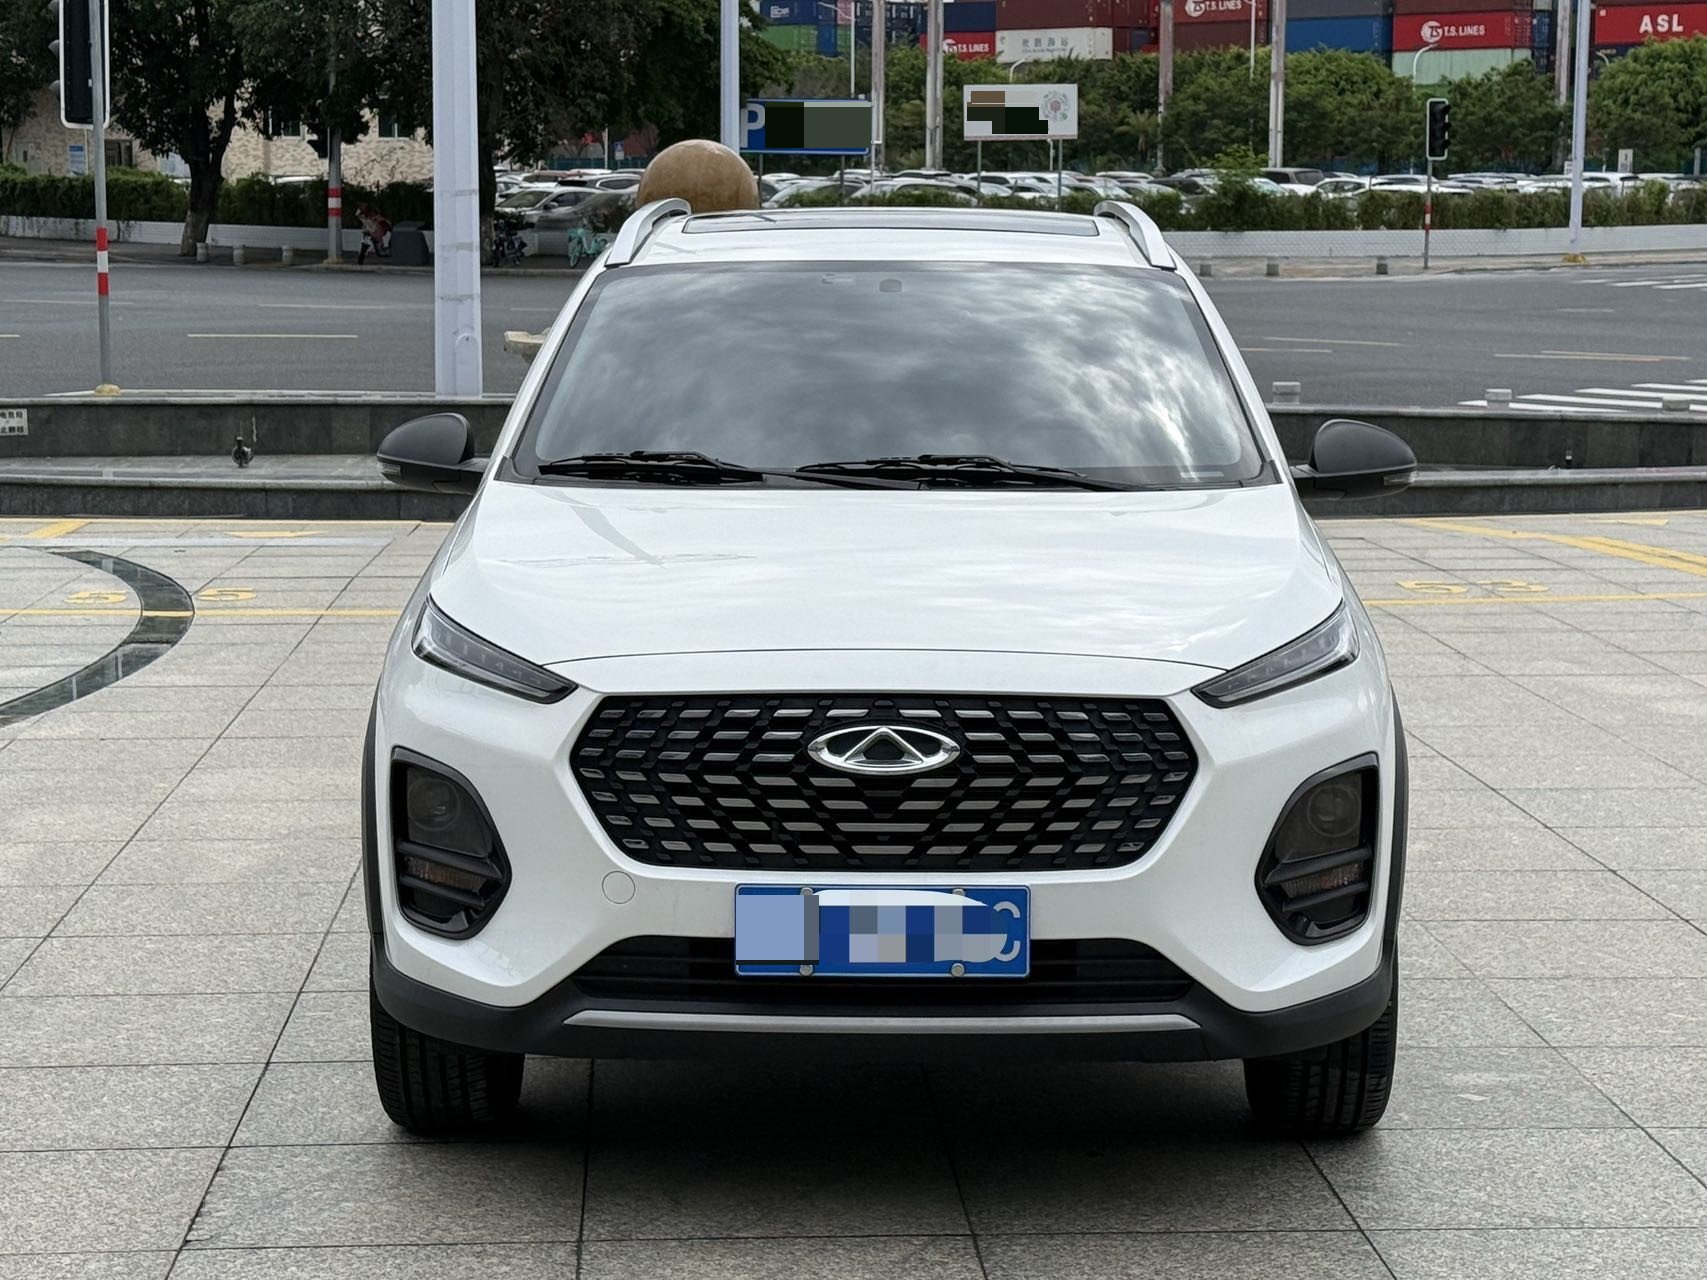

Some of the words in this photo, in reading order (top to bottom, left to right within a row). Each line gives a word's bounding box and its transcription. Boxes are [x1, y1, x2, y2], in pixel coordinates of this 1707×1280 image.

[1218, 0, 1242, 11] LINES
[1639, 13, 1684, 34] ASL
[1443, 26, 1457, 36] T.S.
[1459, 24, 1486, 36] LINES
[969, 43, 990, 52] LINES
[740, 102, 766, 148] P
